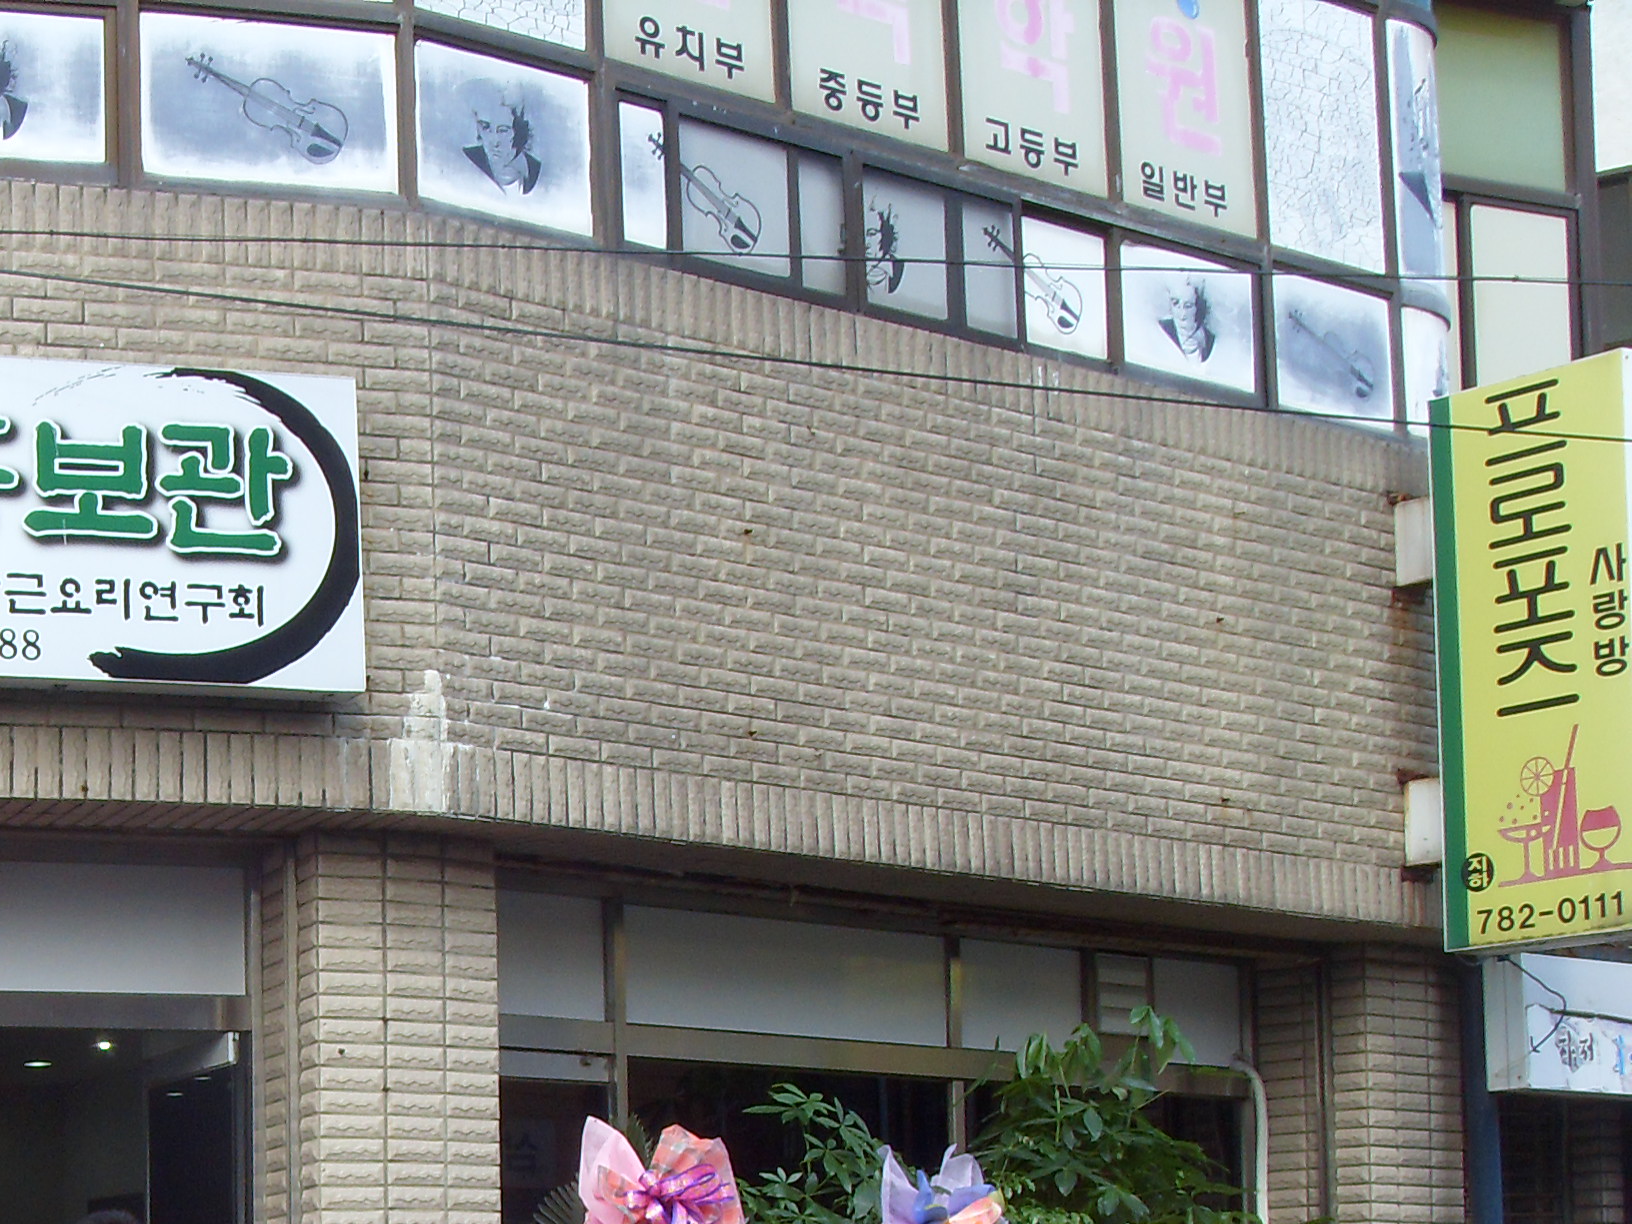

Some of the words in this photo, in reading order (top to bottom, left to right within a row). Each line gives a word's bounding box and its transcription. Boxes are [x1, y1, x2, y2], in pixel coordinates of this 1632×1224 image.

[634, 16, 745, 79] 유치부
[819, 67, 920, 129] 중등부
[984, 117, 1079, 176] 고등부
[1140, 161, 1228, 217] 일반부
[1484, 378, 1580, 718] 프로포즈
[1589, 542, 1630, 677] 사랑방
[1476, 890, 1624, 935] 782-0111
